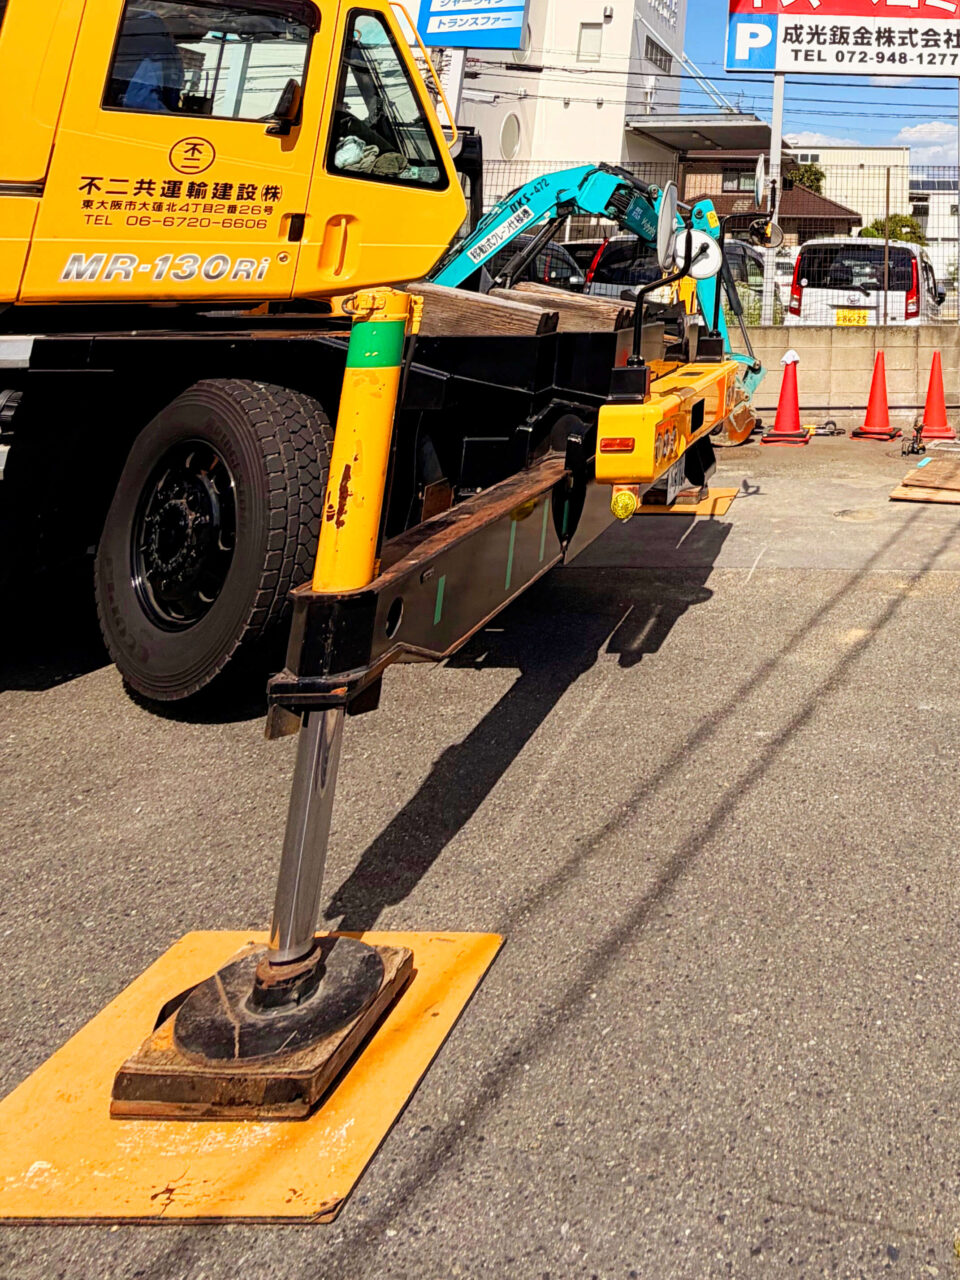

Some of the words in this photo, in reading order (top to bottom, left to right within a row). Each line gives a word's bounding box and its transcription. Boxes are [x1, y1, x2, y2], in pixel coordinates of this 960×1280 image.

[437, 16, 513, 29] トランスファー
[735, 23, 773, 60] P
[791, 49, 827, 62] TEL
[835, 50, 959, 66] 072-948-1277
[83, 214, 113, 226] TEL
[125, 215, 268, 230] 06-6720-6606
